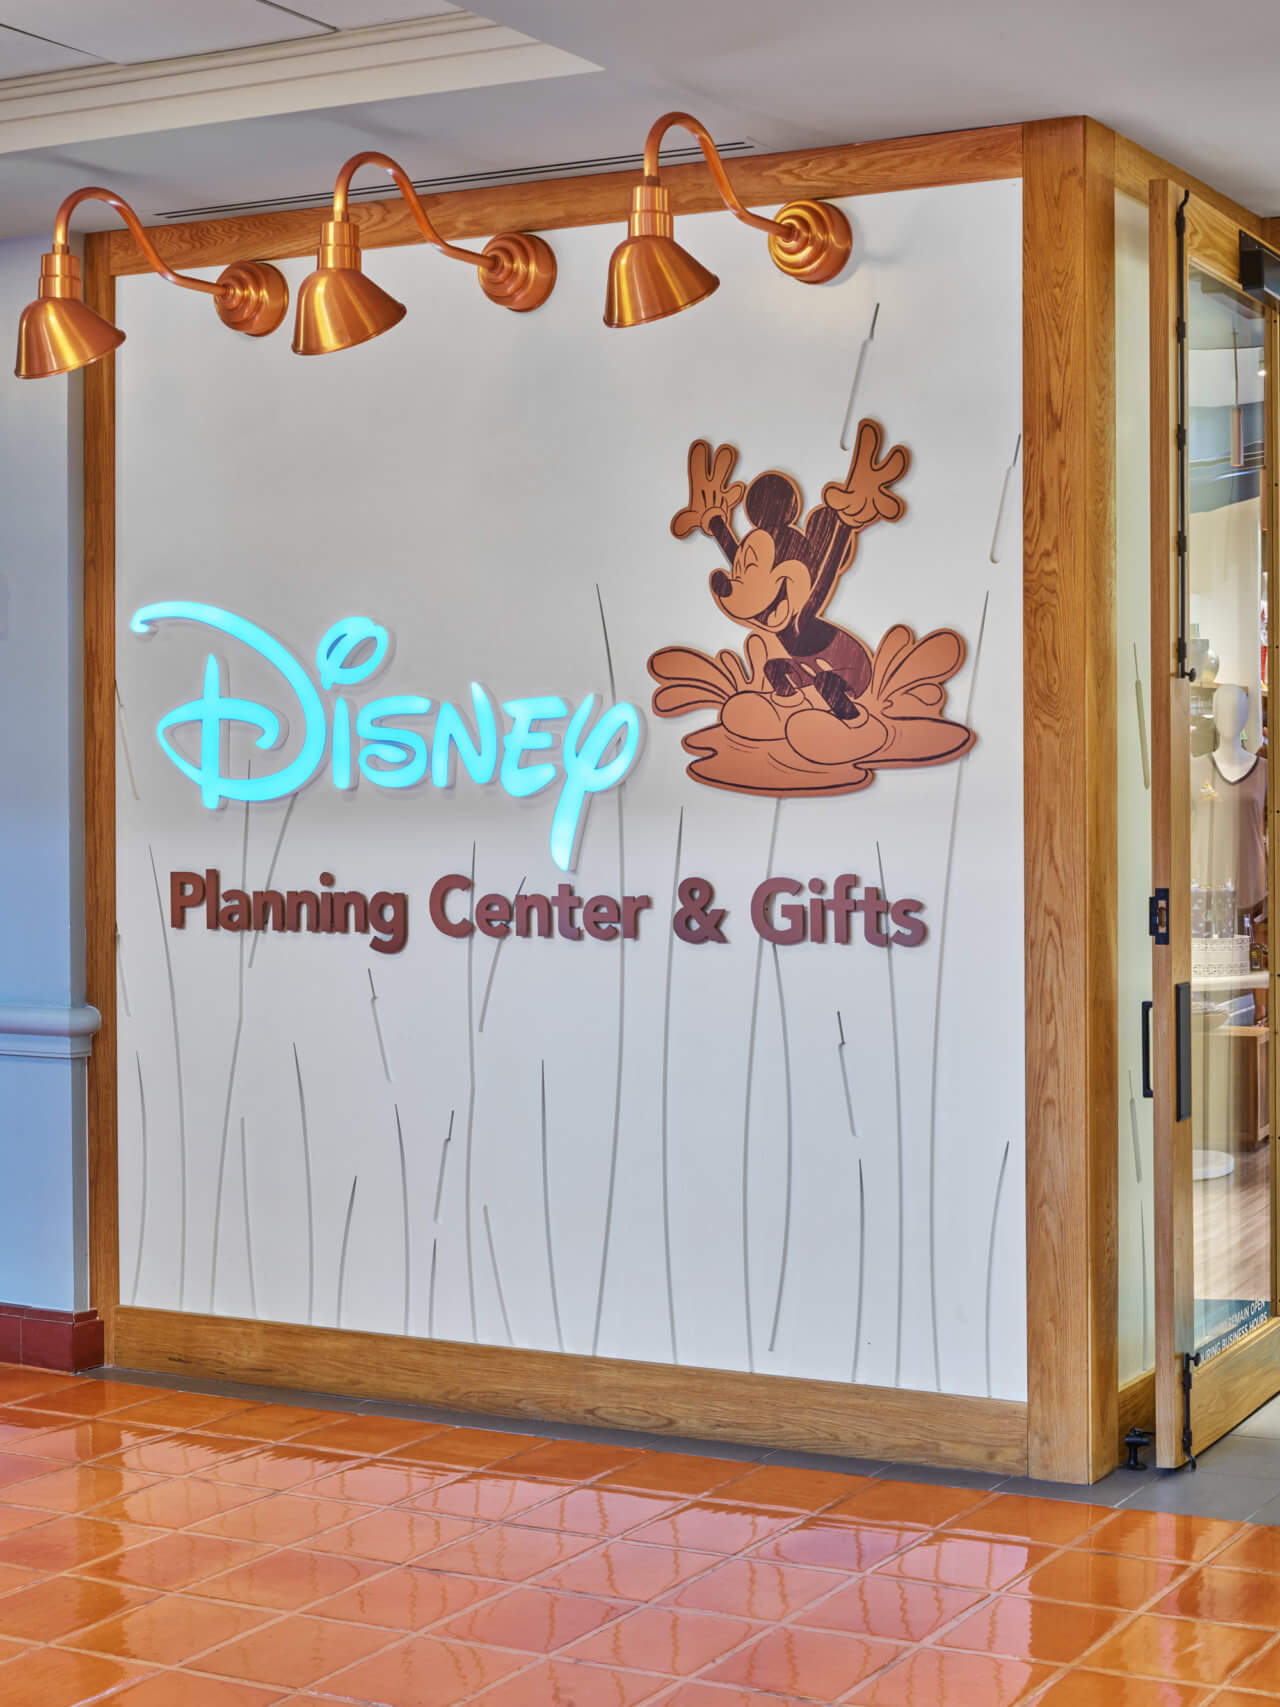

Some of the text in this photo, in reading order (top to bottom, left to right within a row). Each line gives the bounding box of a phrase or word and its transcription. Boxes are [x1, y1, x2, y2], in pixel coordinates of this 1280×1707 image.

[170, 871, 927, 952] Planning Center & Gifts
[1250, 1296, 1265, 1315] OPEN
[1222, 1323, 1249, 1352] BUSINESS
[1249, 1311, 1268, 1331] HOURS
